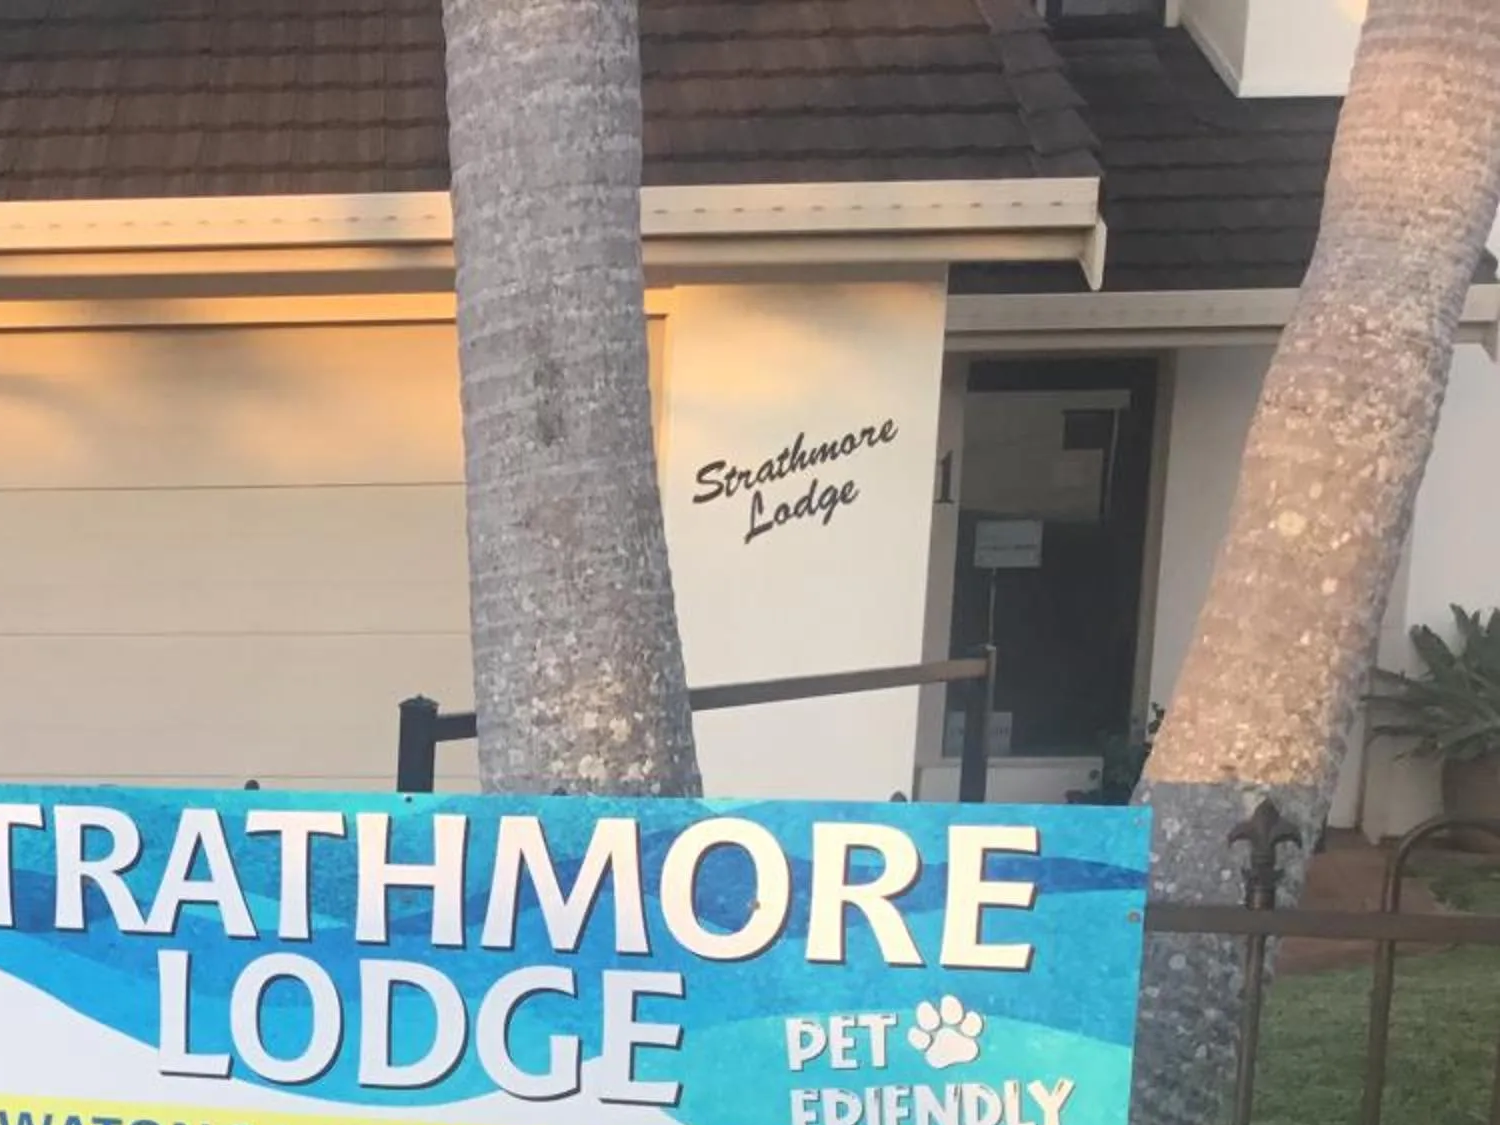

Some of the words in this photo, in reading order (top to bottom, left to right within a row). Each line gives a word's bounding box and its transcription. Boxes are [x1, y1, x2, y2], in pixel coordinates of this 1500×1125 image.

[693, 416, 899, 506] Strathmore
[934, 450, 954, 504] 1
[744, 476, 860, 543] Lodge
[157, 949, 685, 1106] LODGE
[785, 1013, 897, 1072] PET
